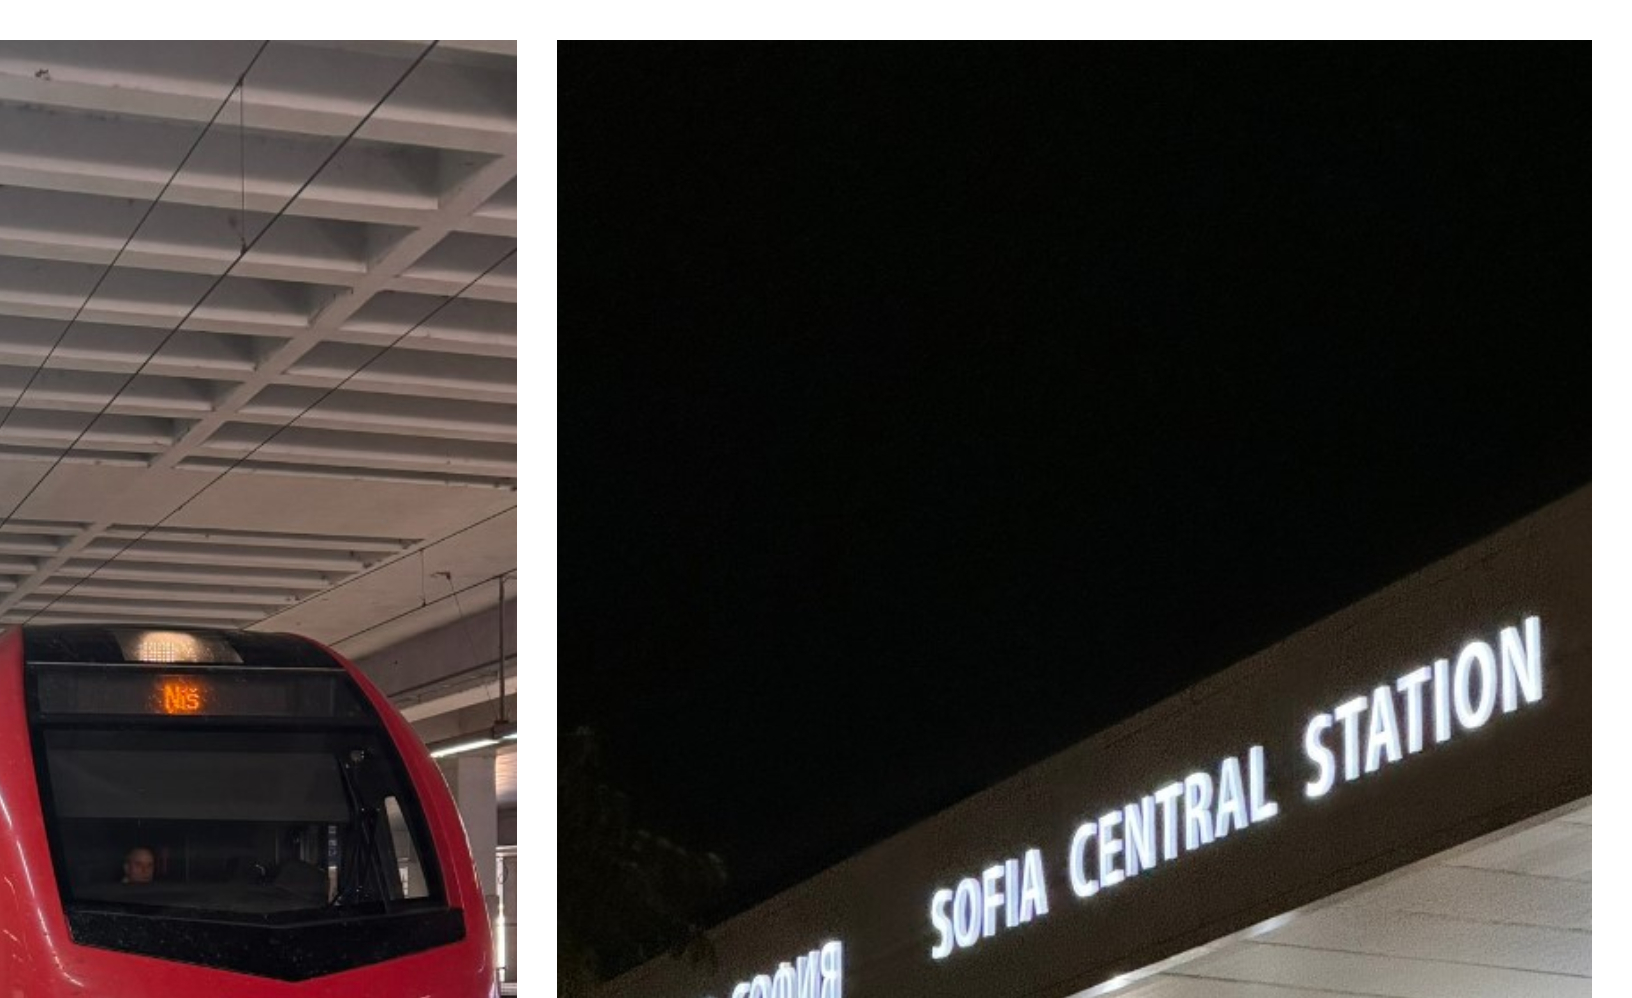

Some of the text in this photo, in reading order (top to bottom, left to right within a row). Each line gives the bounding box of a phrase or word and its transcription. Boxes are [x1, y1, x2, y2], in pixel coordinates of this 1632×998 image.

[929, 615, 1543, 960] SOFIA CENTRAL STATION
